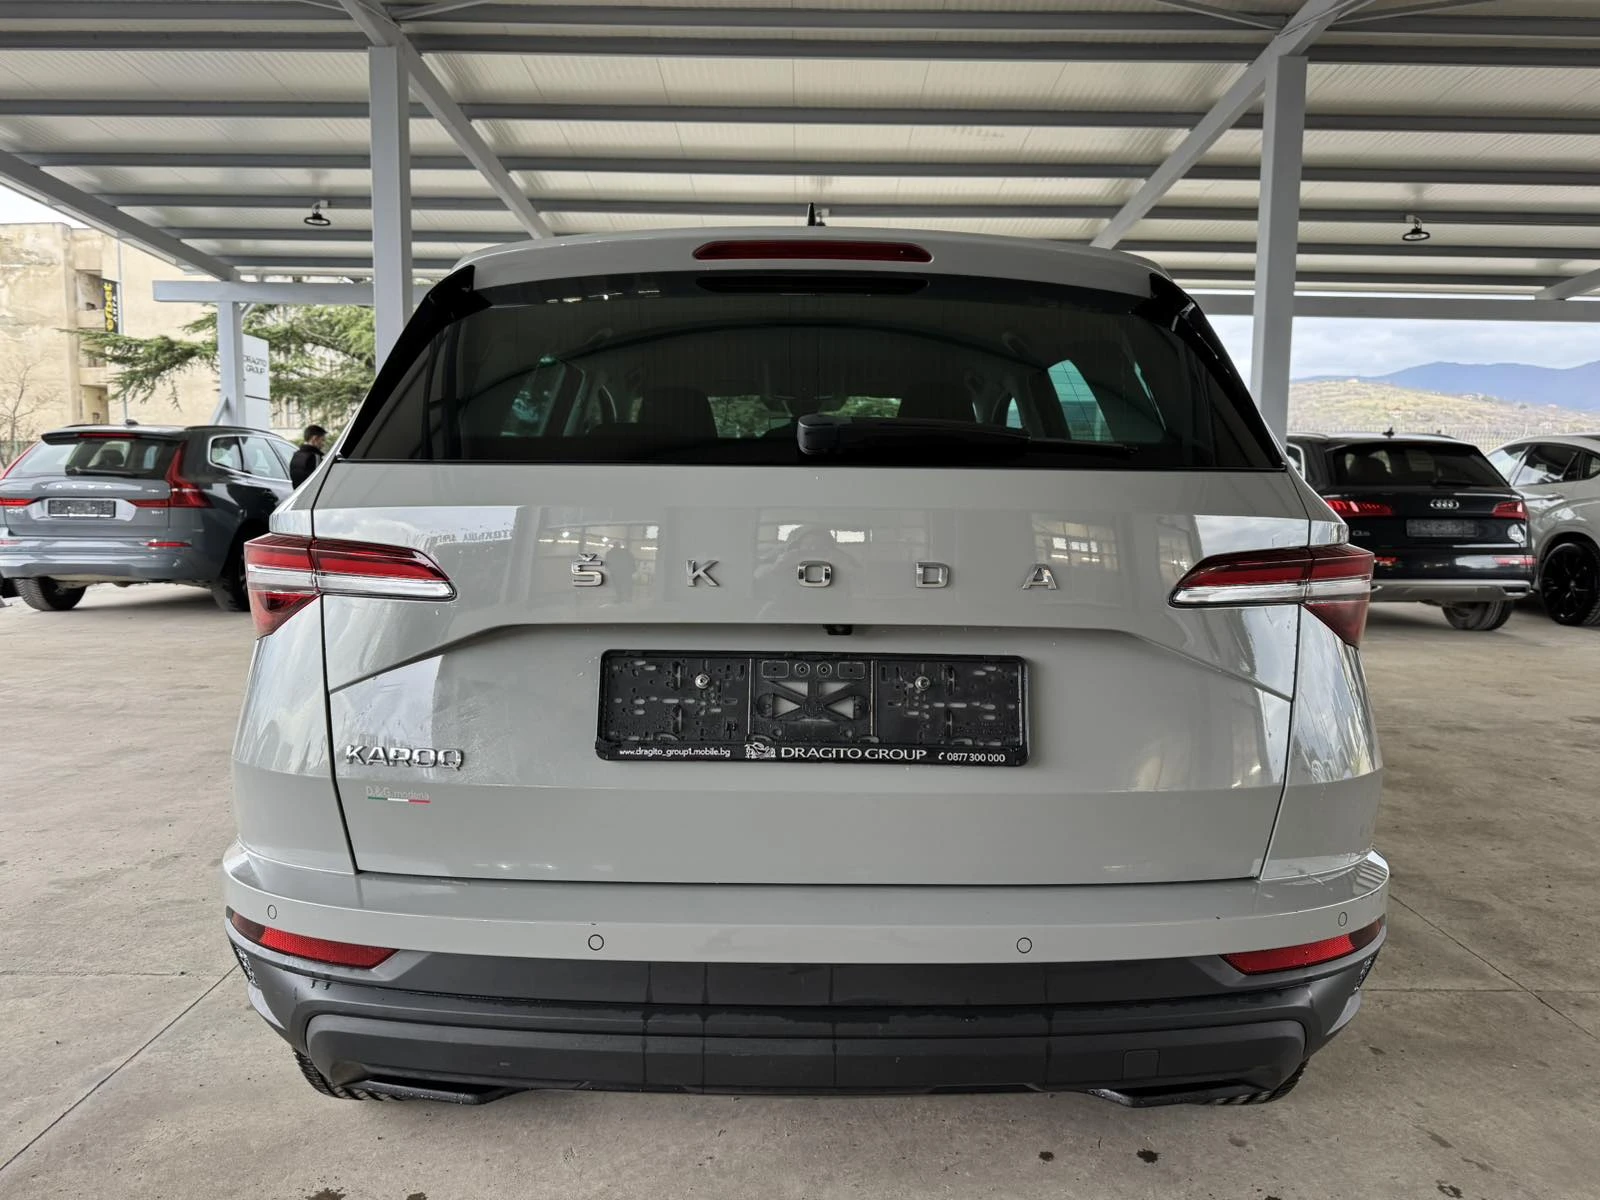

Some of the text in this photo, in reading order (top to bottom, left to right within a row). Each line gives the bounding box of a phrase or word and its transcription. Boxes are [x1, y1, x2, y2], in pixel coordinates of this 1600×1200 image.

[571, 553, 1059, 591] ŠKODA
[346, 744, 465, 771] KAROQ
[619, 746, 731, 758] www.dragito_group1.mobile.bg
[781, 747, 928, 760] DRAGITO GROUP
[947, 752, 1006, 763] 0877 300 000
